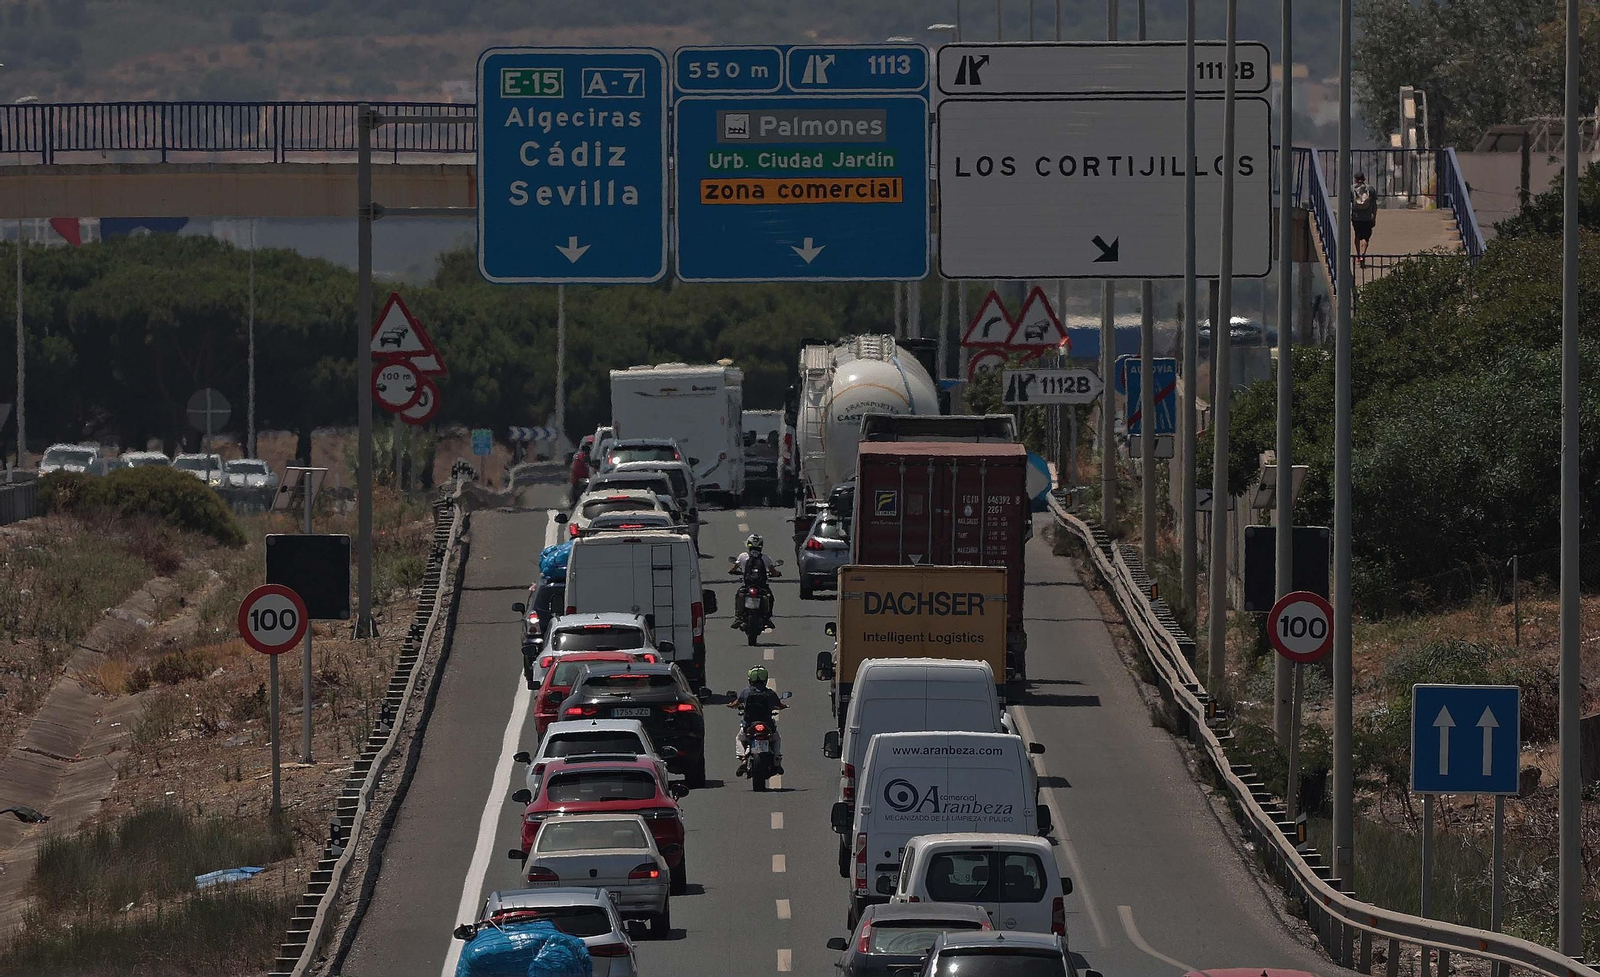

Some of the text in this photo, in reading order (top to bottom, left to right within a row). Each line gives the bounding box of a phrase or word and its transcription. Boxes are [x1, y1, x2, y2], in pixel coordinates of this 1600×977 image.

[688, 61, 769, 79] 550 m
[867, 54, 911, 75] 1113
[504, 72, 560, 94] E-15
[587, 72, 640, 94] A-7
[504, 107, 642, 134] Algeciras
[759, 115, 884, 137] Palmones
[519, 140, 626, 167] Cádiz
[708, 151, 895, 169] Urb. Ciudad Jardín
[955, 156, 1017, 177] LOS
[509, 179, 639, 206] Sevilla
[705, 179, 899, 200] zona comercial
[1041, 377, 1090, 394] 1112B
[864, 592, 984, 615] DACHSER
[250, 608, 297, 632] 100
[1280, 615, 1327, 639] 100
[863, 631, 984, 645] Intelligent Logistics
[892, 745, 1003, 756] www.aranbeza.com
[914, 785, 1013, 815] Aranbeza
[940, 794, 977, 802] comercial
[885, 814, 930, 822] MECANIZADO
